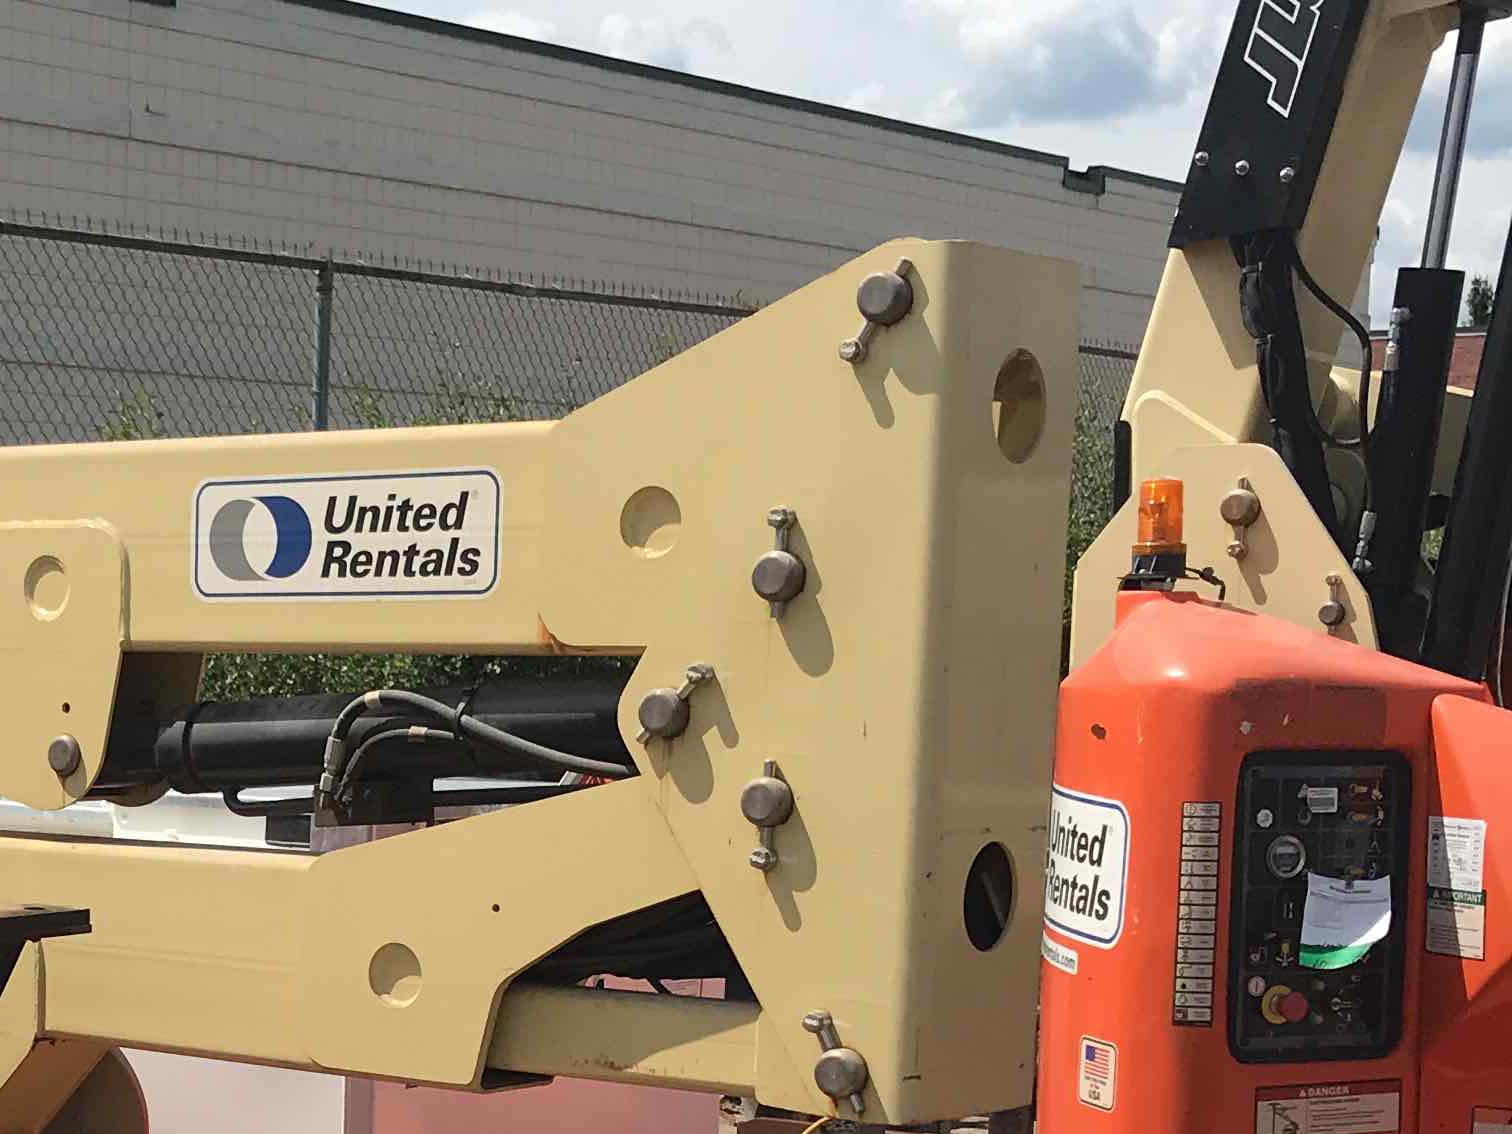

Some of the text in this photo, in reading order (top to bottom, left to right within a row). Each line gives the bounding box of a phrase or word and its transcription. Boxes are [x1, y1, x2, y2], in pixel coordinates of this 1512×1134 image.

[1243, 0, 1322, 118] JL
[323, 490, 470, 535] United
[320, 537, 481, 578] Rentals
[1051, 809, 1108, 867] United
[1048, 858, 1111, 921] Rentals
